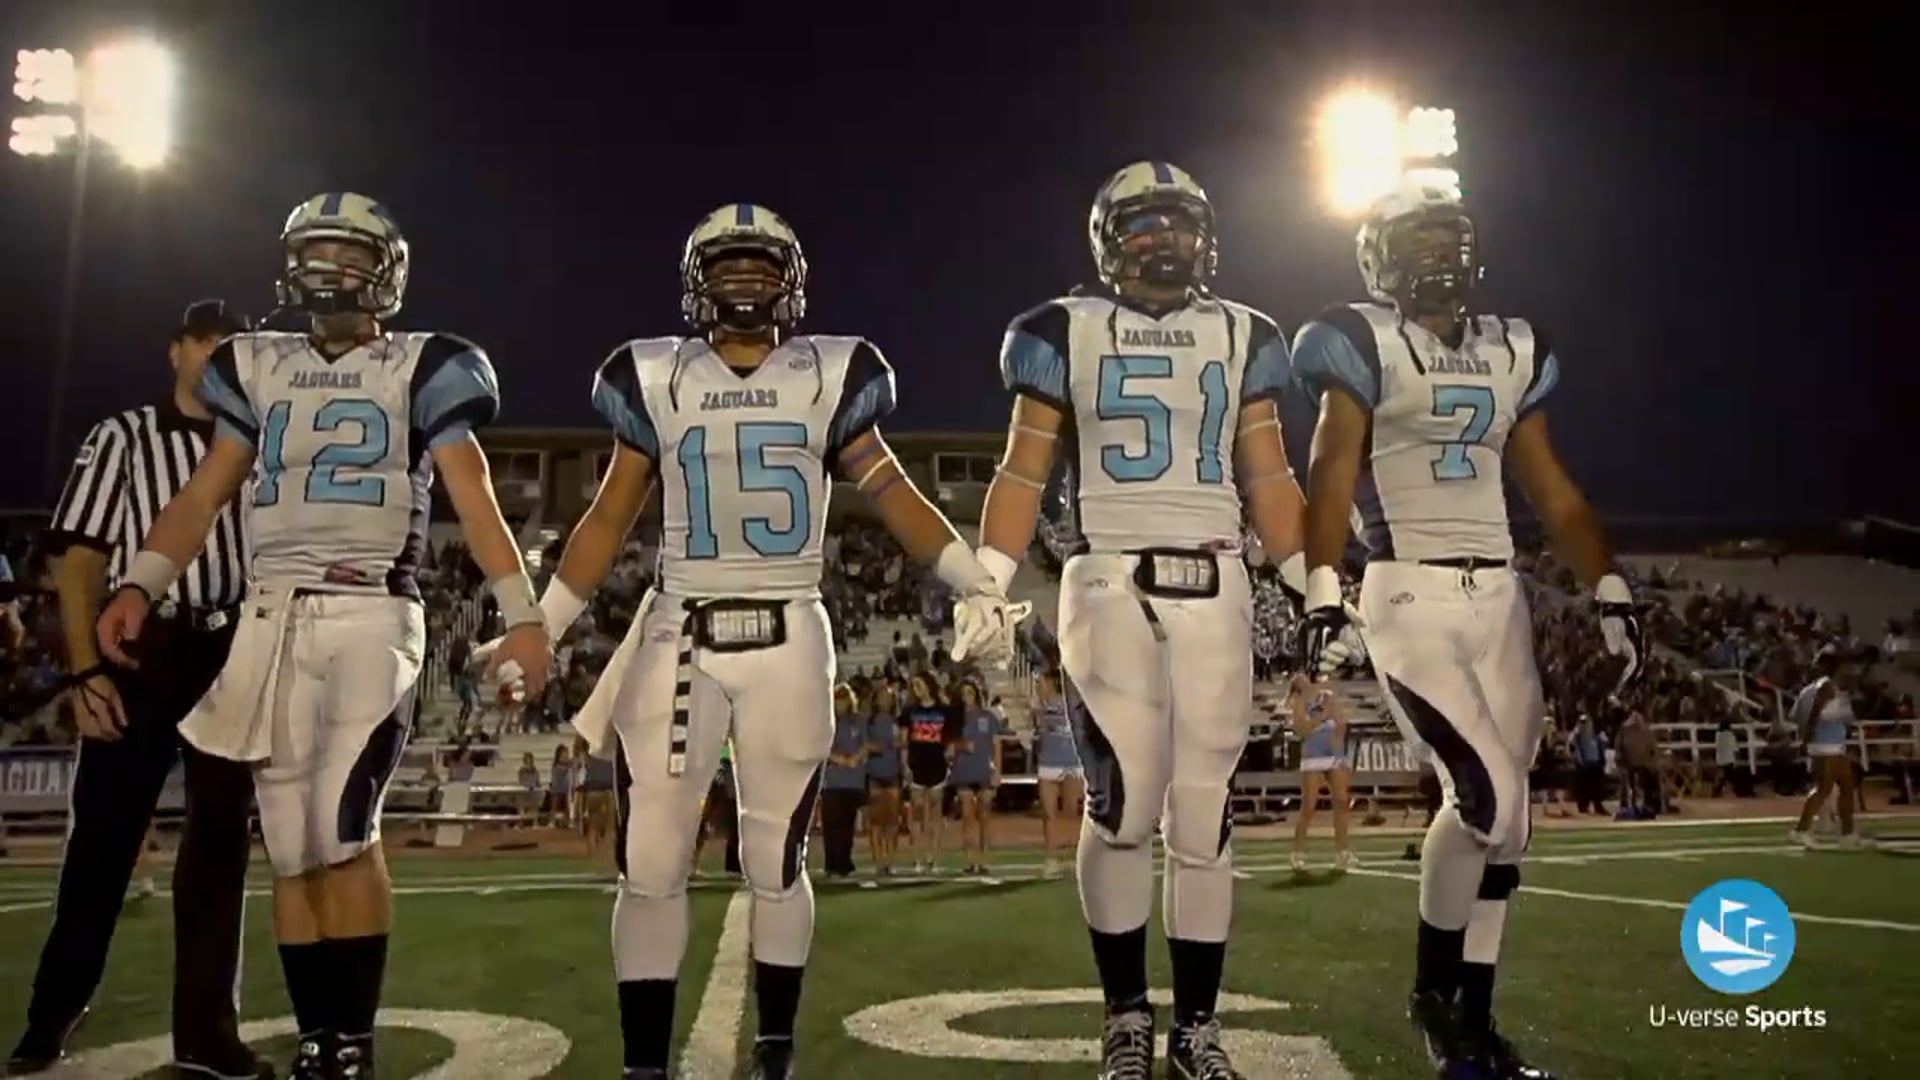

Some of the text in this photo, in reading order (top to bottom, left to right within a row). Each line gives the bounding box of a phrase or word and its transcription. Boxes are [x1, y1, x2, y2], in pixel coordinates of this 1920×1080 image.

[1120, 329, 1196, 347] JAGUARS
[1428, 357, 1492, 375] JAGUARS
[288, 371, 363, 389] JAGUARS
[699, 388, 778, 411] JAGUARS
[1097, 355, 1229, 484] 51
[1431, 384, 1496, 482] 7
[252, 397, 390, 508] 12
[677, 420, 811, 560] 15
